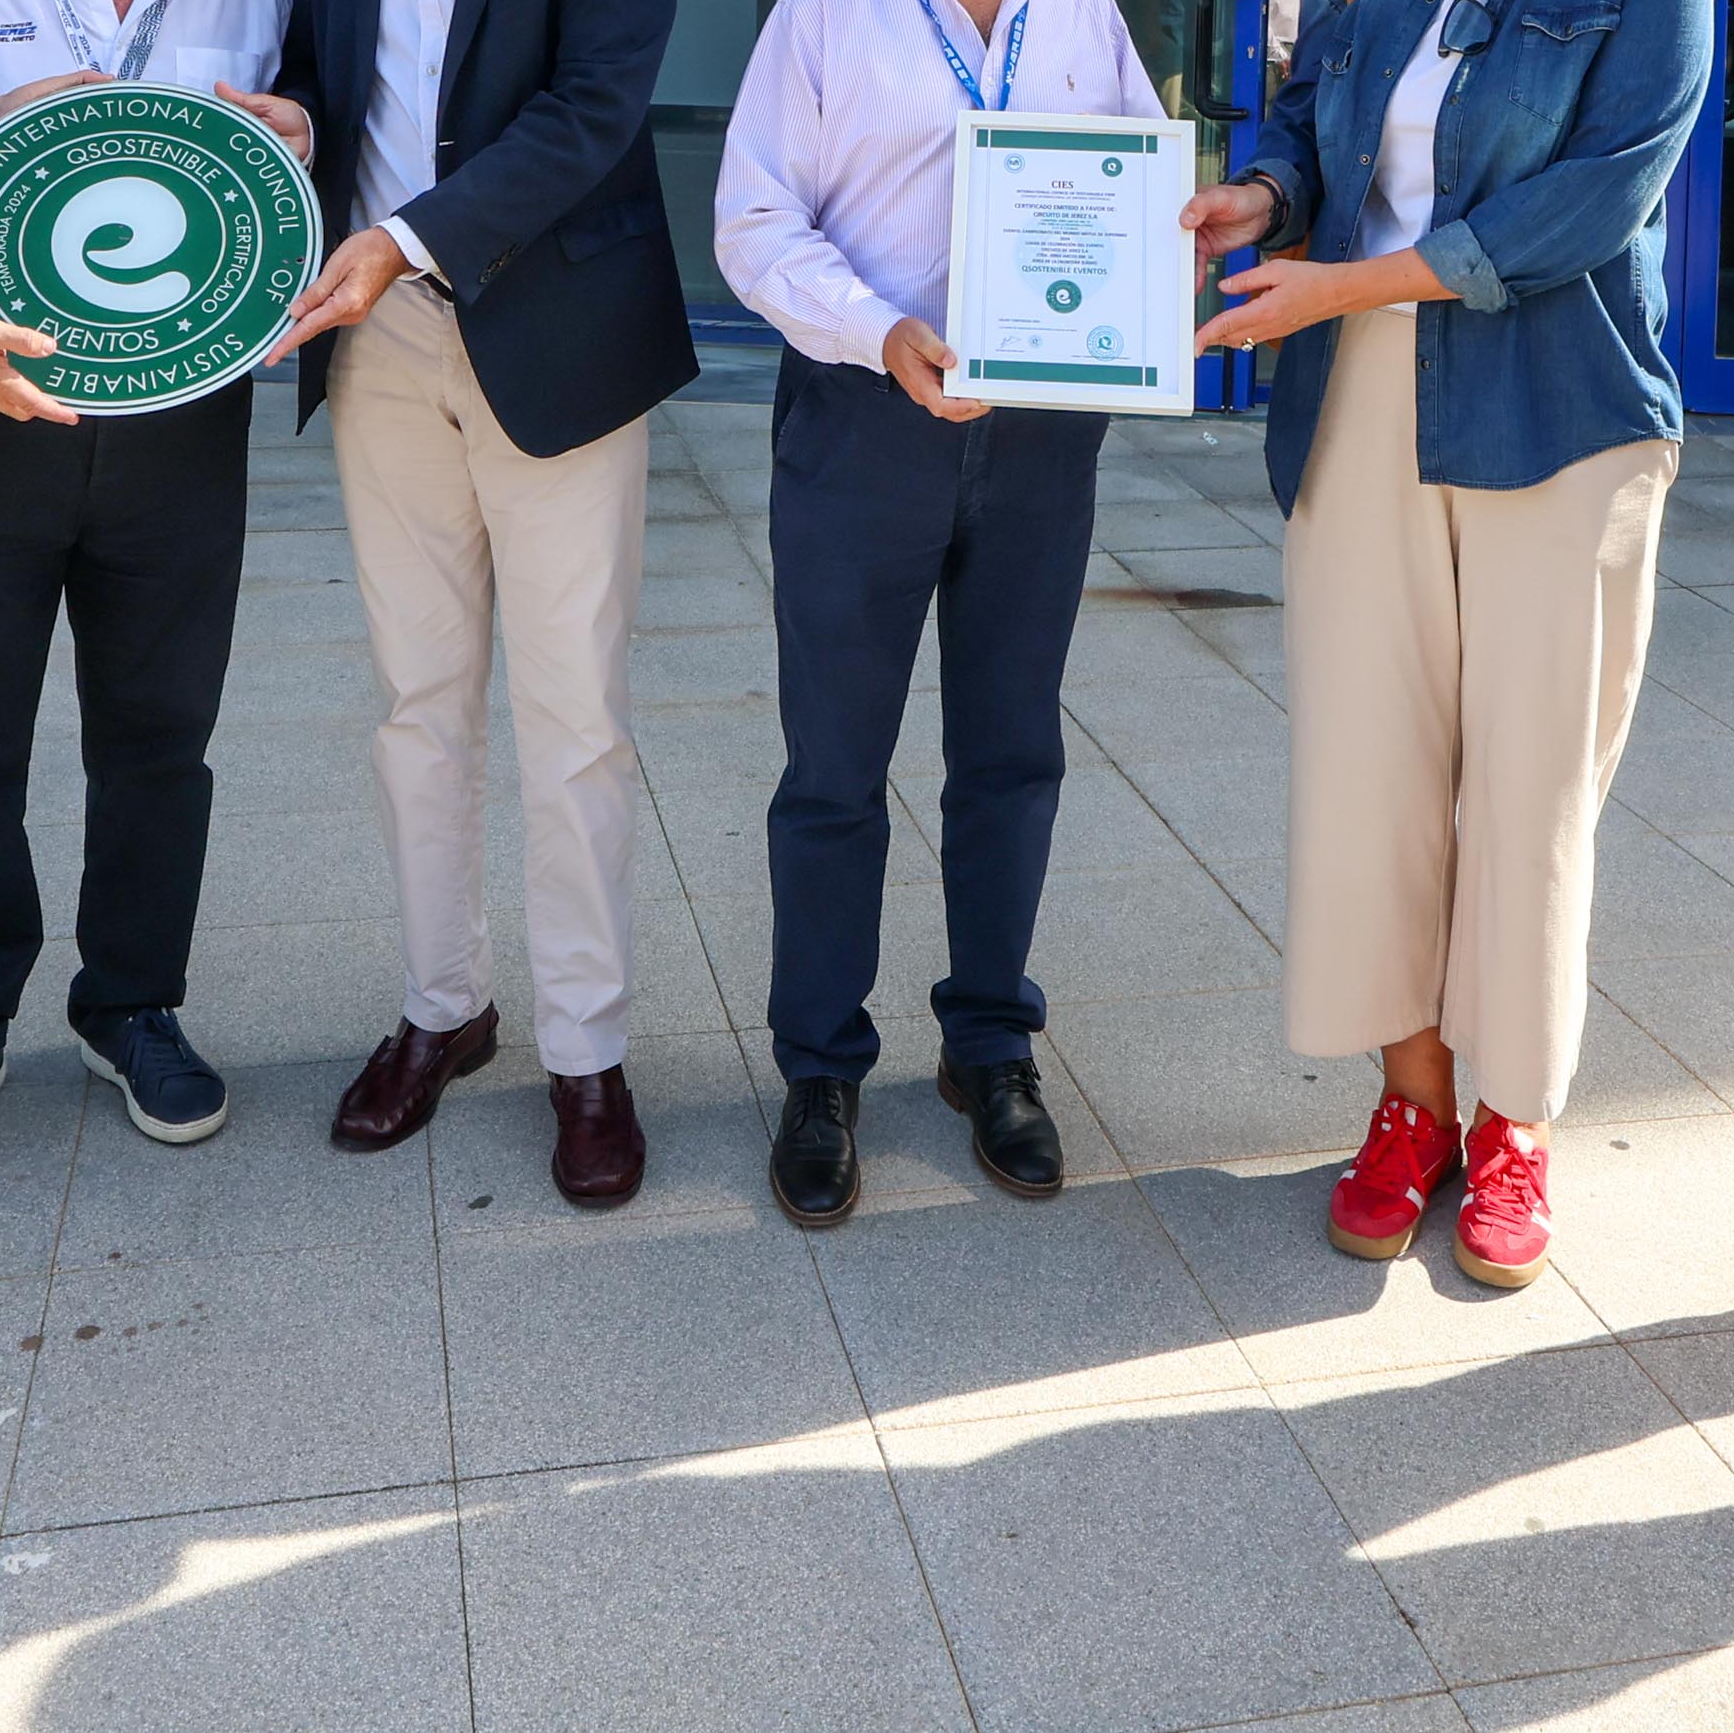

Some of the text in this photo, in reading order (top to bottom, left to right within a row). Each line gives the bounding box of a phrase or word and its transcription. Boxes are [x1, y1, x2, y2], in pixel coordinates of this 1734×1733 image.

[66, 138, 223, 185] QSOSTENIBLE
[6, 184, 32, 216] 2024
[228, 132, 300, 234] COUNCIL
[1051, 180, 1075, 189] CIES
[1014, 202, 1053, 210] CERTIFICADO
[1033, 211, 1061, 219] CIRCUITO
[201, 212, 252, 313] CERTIFICADO
[1021, 265, 1108, 276] QSOSTENIBLE EVENTOS
[265, 268, 294, 306] OF
[45, 332, 245, 394] SUSTAINABLE
